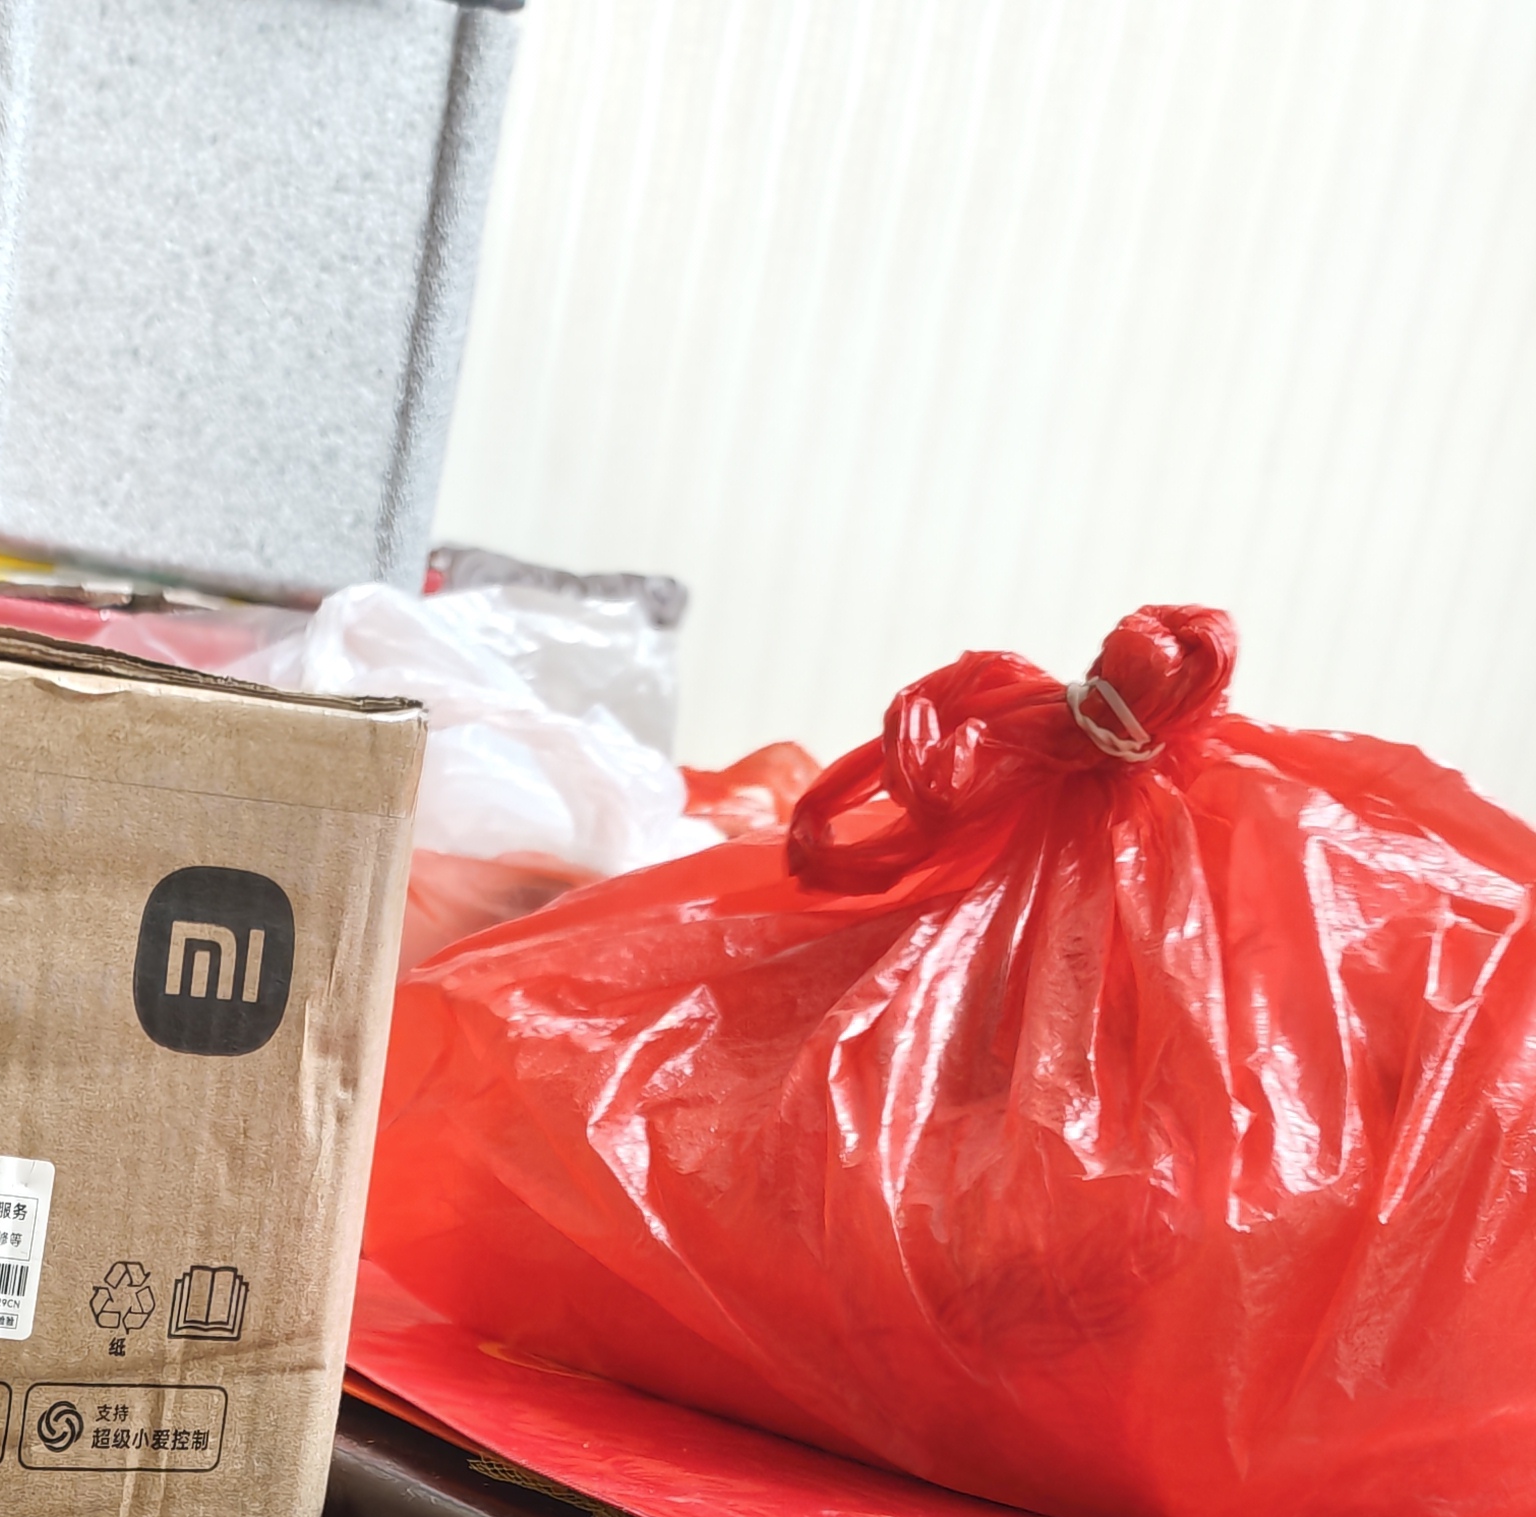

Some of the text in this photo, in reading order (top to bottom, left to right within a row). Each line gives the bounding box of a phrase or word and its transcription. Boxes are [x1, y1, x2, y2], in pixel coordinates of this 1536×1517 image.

[94, 1403, 130, 1424] 支持
[90, 1425, 211, 1453] 超级小爱控制
